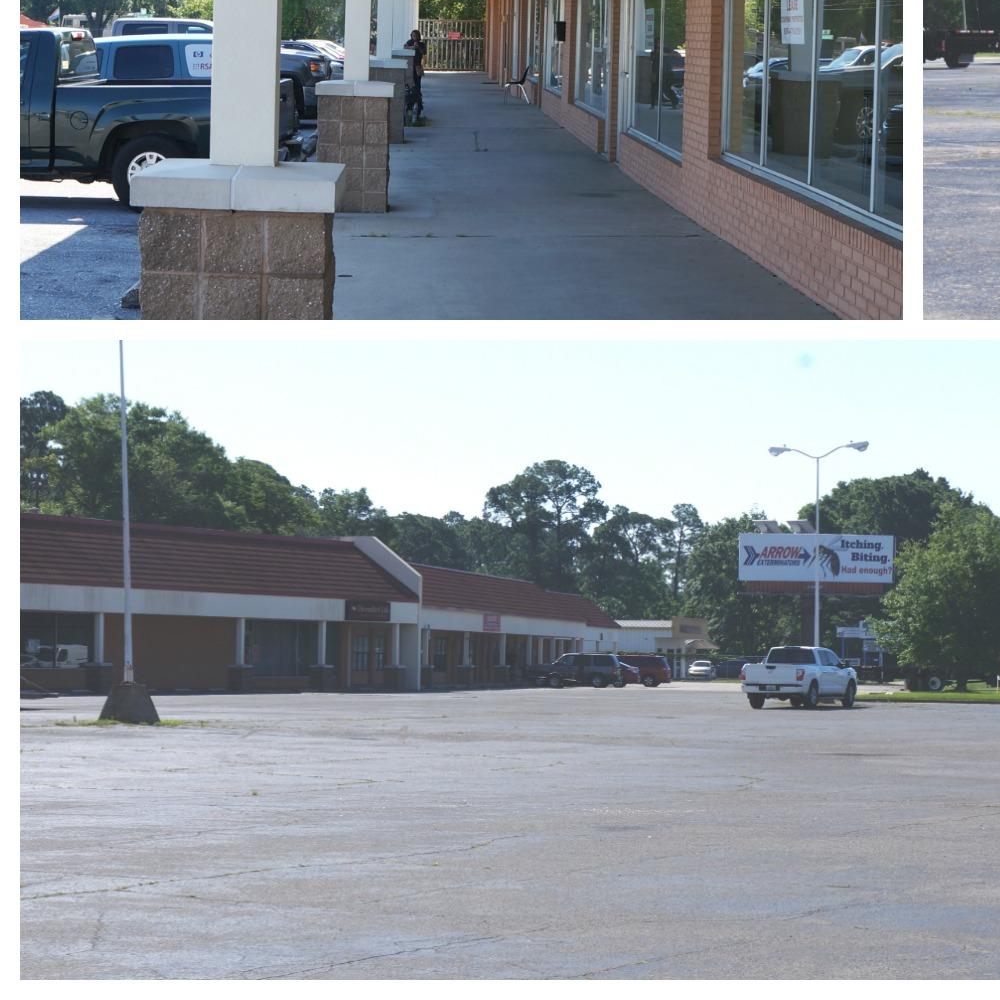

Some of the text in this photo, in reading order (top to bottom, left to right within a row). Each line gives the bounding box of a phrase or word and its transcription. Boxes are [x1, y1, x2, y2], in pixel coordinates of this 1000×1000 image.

[759, 545, 801, 559] ARROW
[841, 540, 884, 552] Itching.
[851, 552, 891, 564] Biting.
[841, 566, 893, 577] Had enough?
